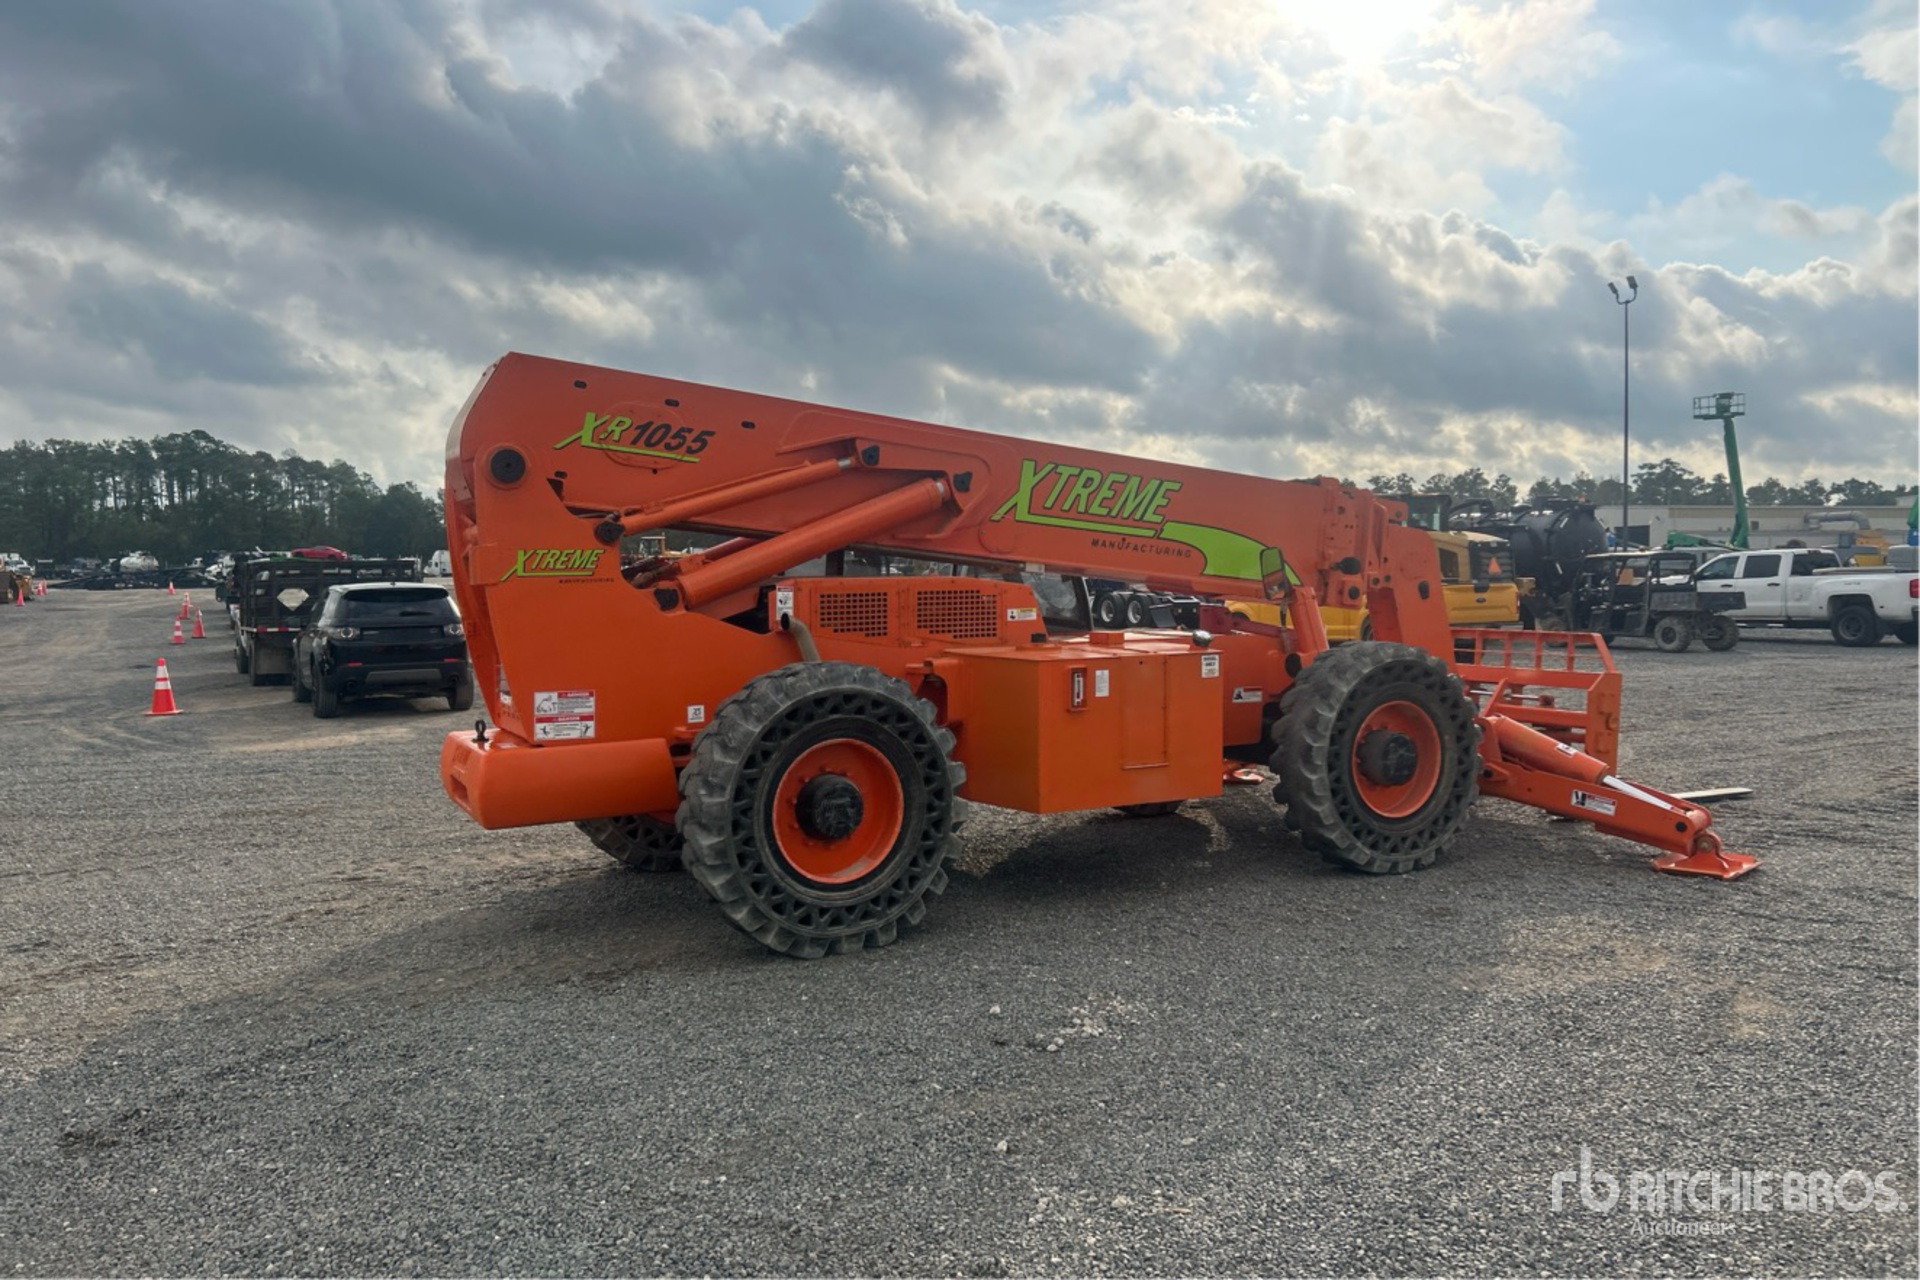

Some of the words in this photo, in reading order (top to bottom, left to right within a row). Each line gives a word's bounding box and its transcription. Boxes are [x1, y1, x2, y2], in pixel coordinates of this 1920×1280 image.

[989, 458, 1184, 526] XTREME
[500, 548, 606, 582] XTREME
[1091, 538, 1192, 558] MANUFACTURING
